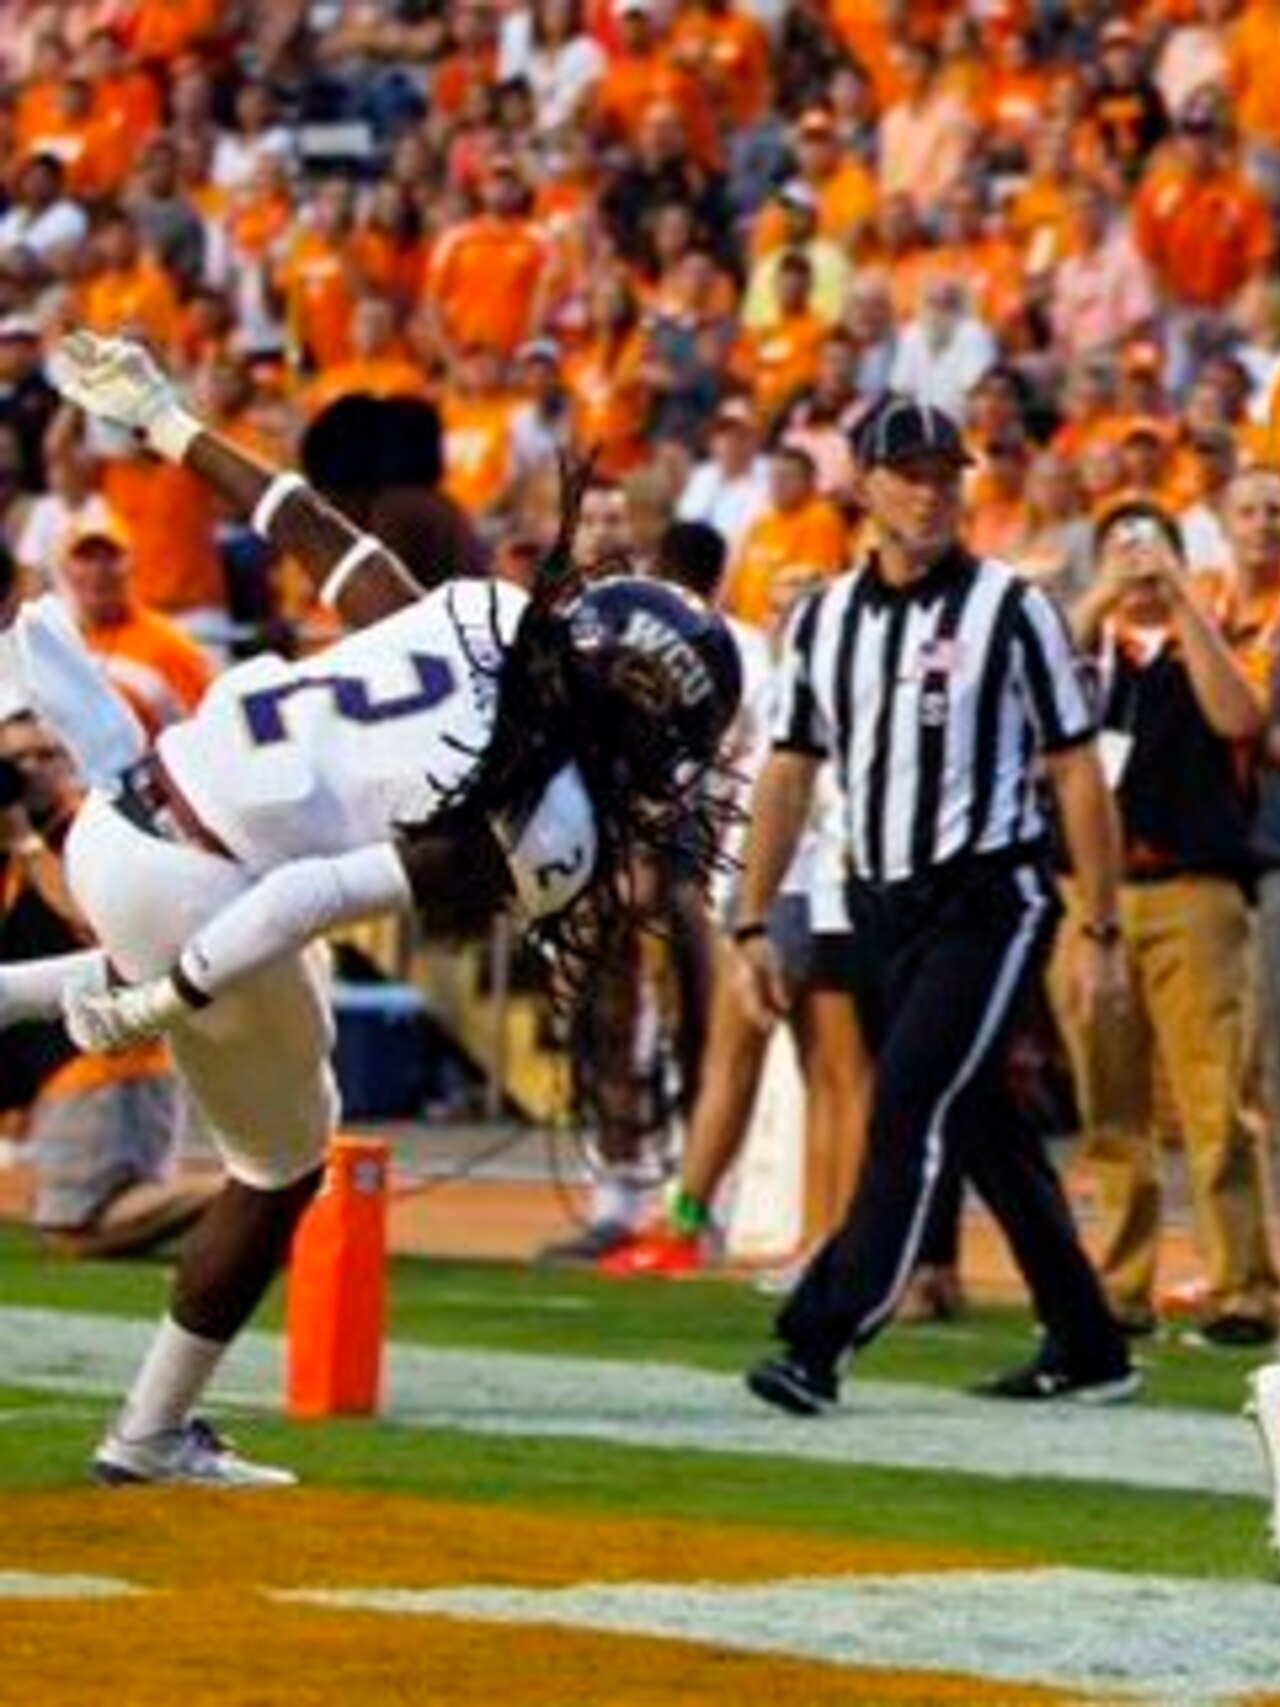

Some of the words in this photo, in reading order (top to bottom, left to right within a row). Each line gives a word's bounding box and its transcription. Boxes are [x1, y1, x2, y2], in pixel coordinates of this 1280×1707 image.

[241, 652, 458, 745] 2
[619, 609, 715, 707] WCU
[537, 844, 584, 890] 2
